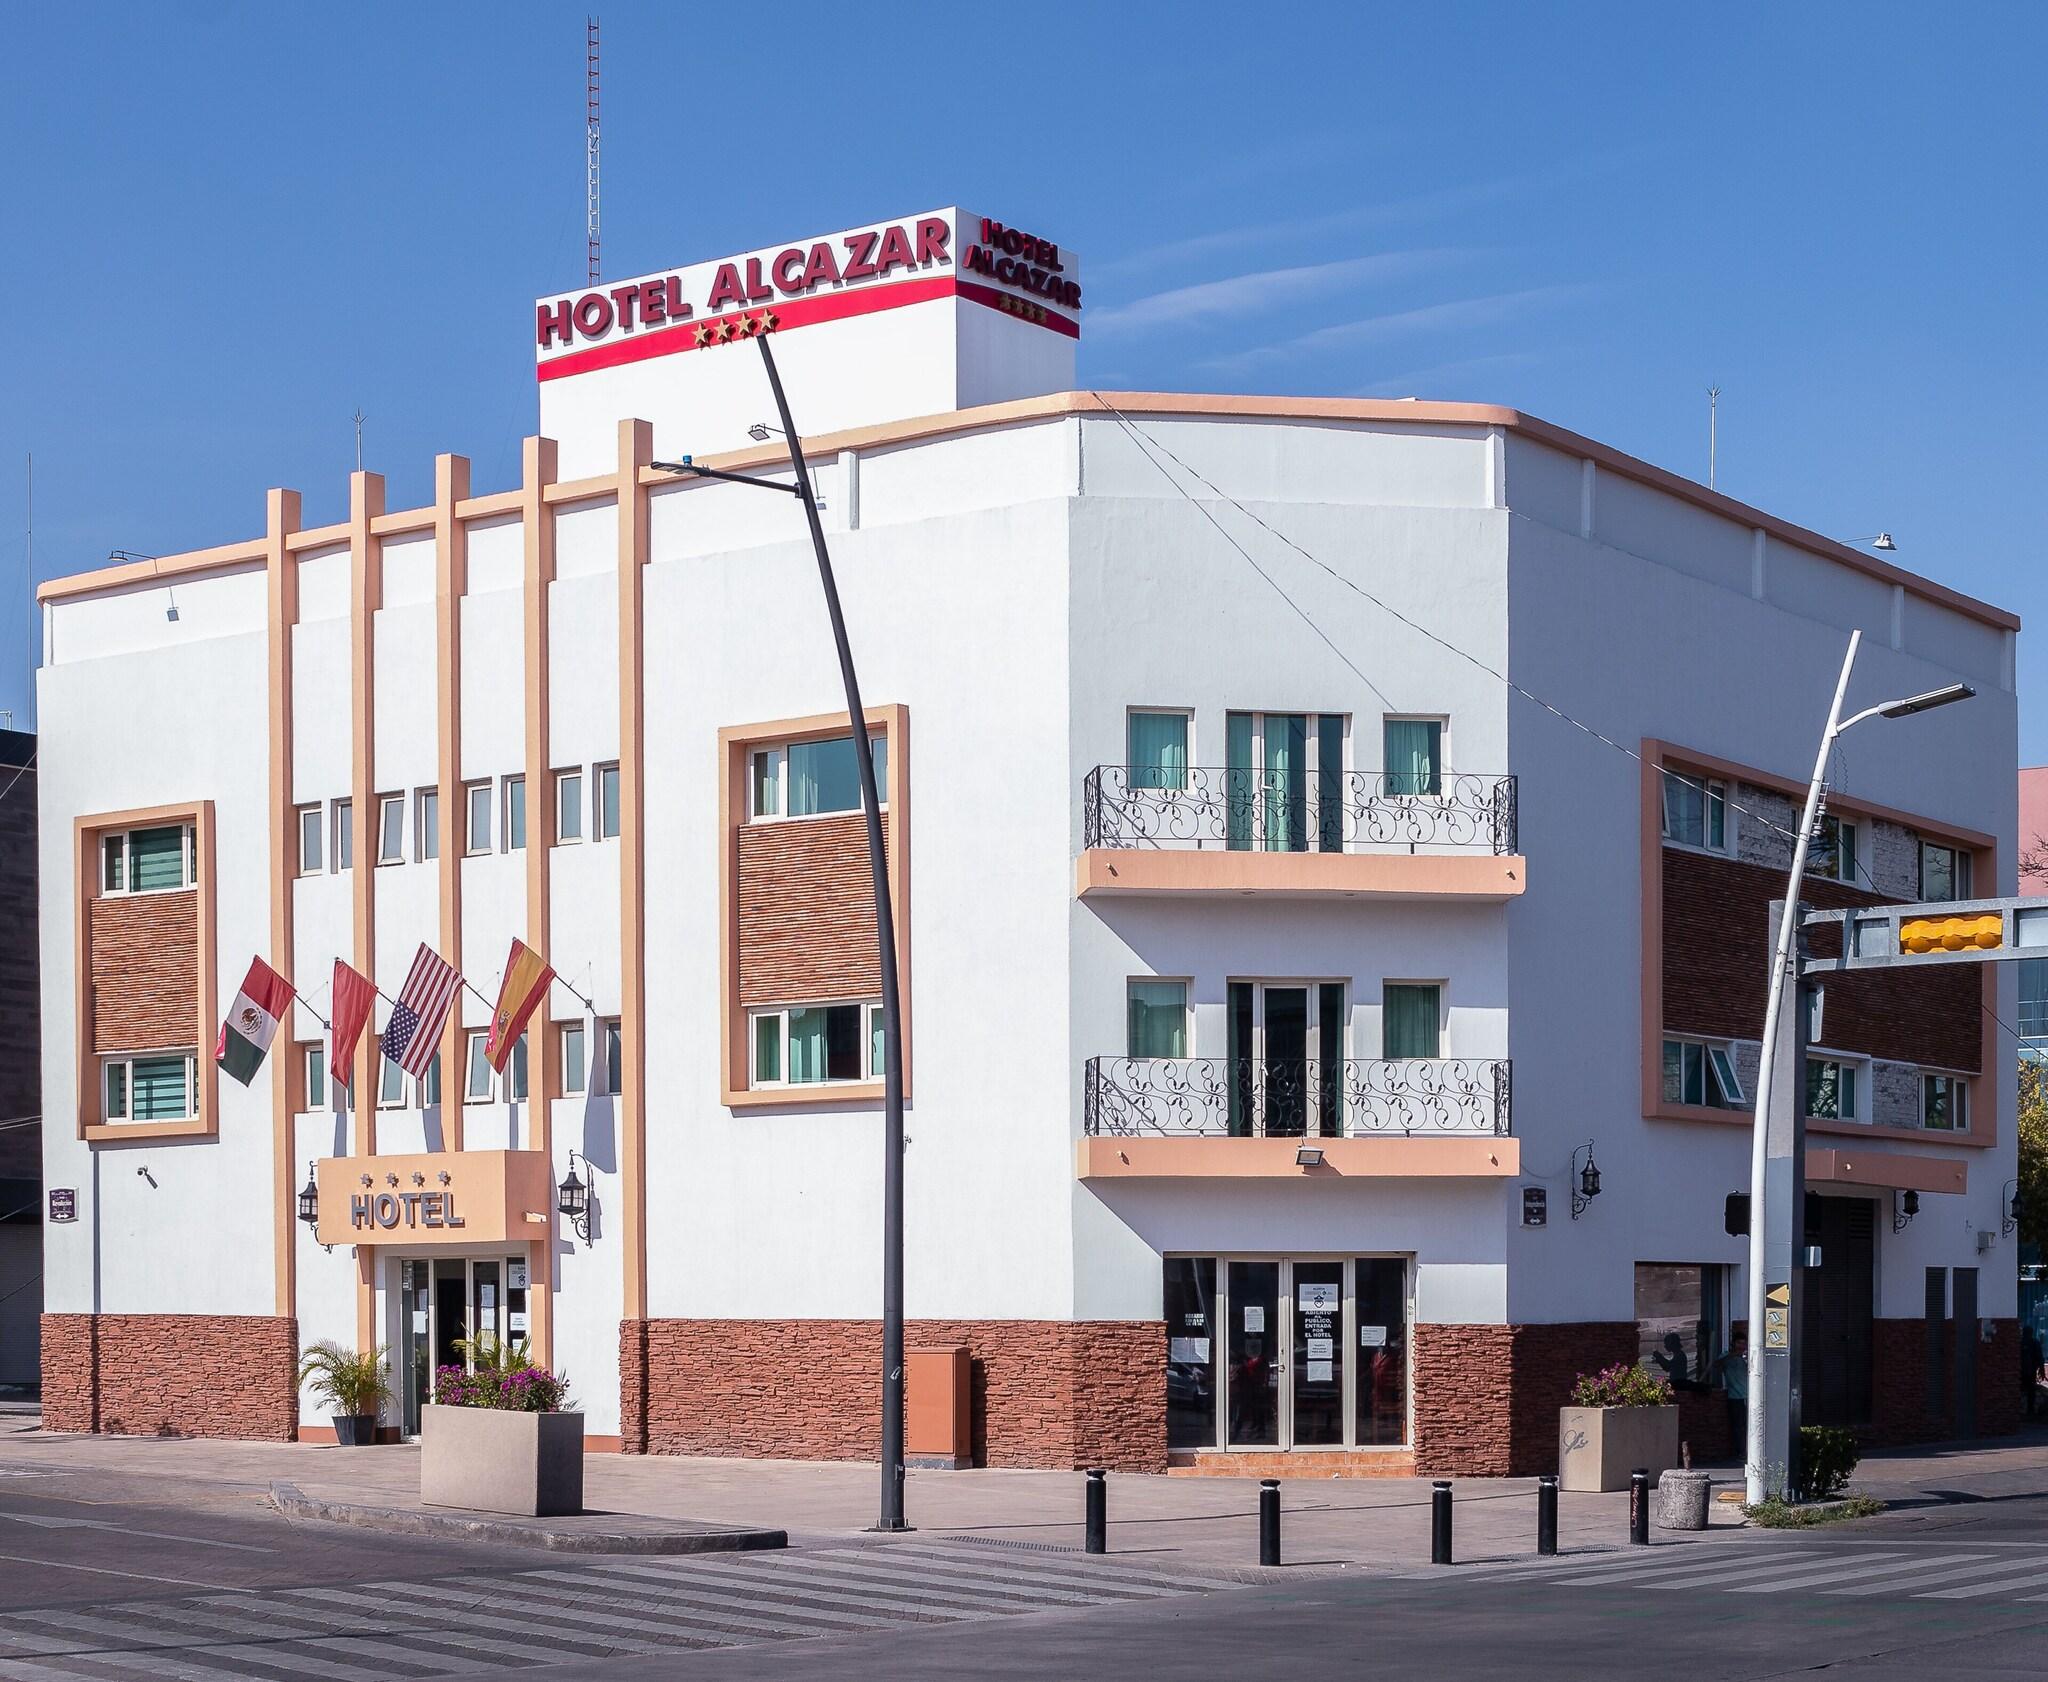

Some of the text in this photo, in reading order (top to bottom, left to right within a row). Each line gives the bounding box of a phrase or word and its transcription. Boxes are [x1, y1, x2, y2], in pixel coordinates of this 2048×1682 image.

[981, 217, 1064, 272] HOTEL
[537, 217, 952, 348] HOTEL ALCAZAR
[962, 244, 1082, 309] ALCAZAR
[351, 1191, 465, 1230] HOTEL
